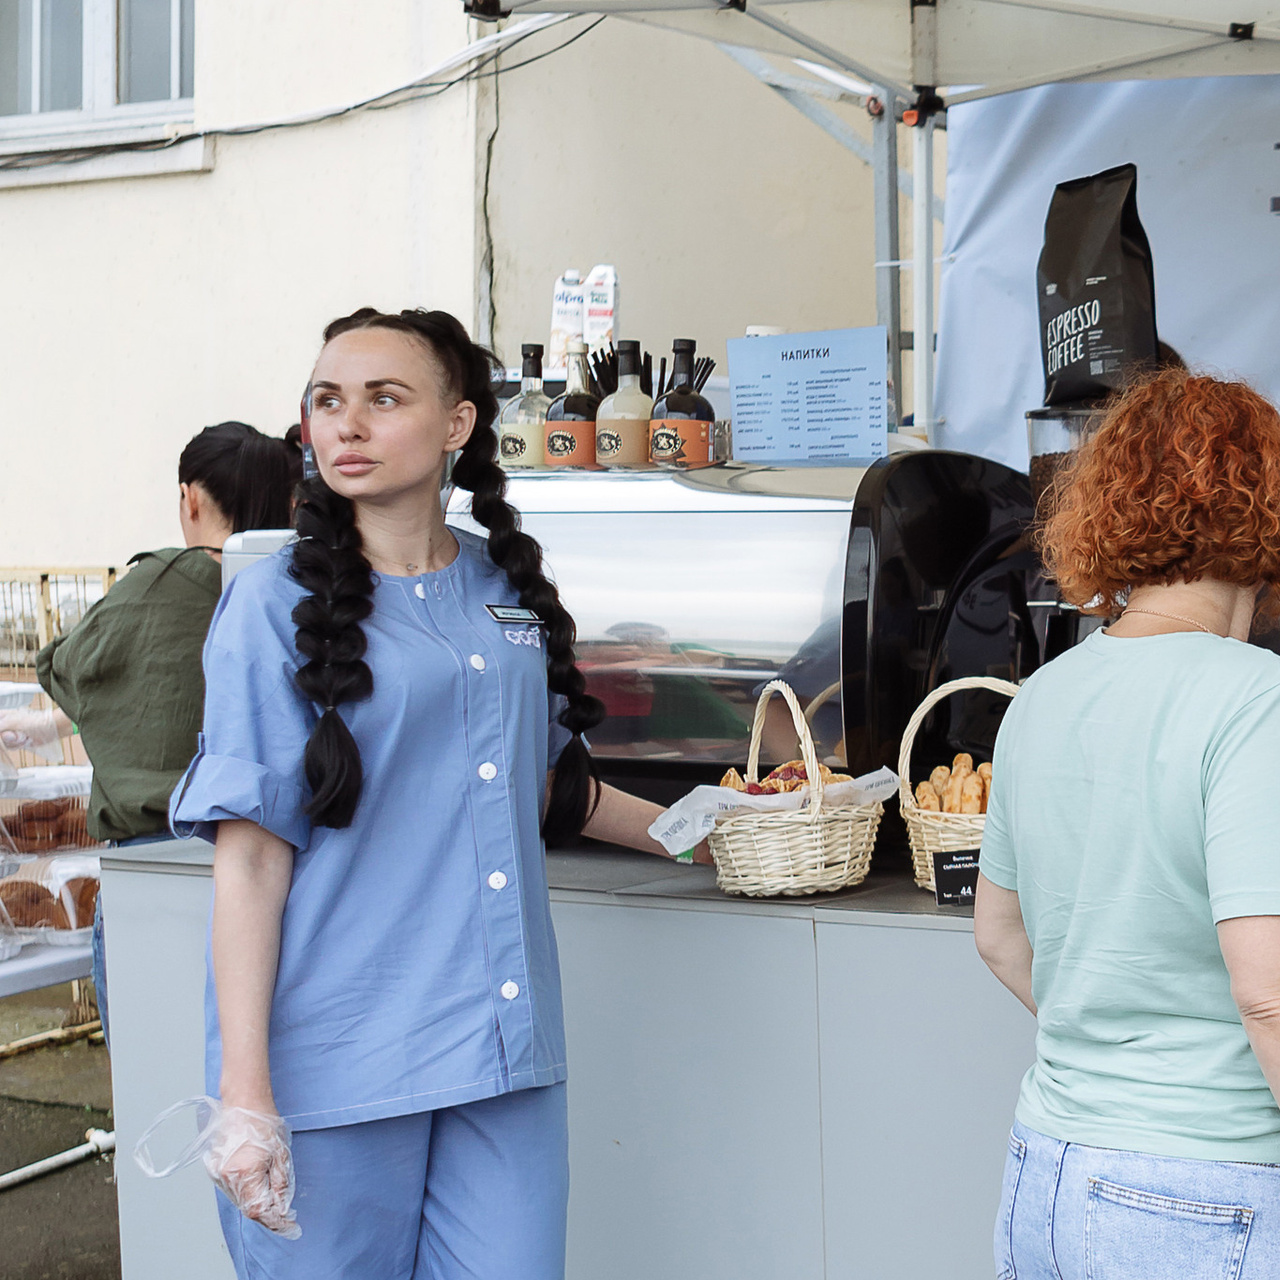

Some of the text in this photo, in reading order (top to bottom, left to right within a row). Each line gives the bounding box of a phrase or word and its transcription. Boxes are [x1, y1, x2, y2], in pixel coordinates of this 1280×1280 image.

[1046, 299, 1100, 350] ESPRESSO
[781, 347, 830, 361] НАПИТКИ
[1047, 333, 1085, 376] COFFEE
[960, 885, 972, 895] 44
